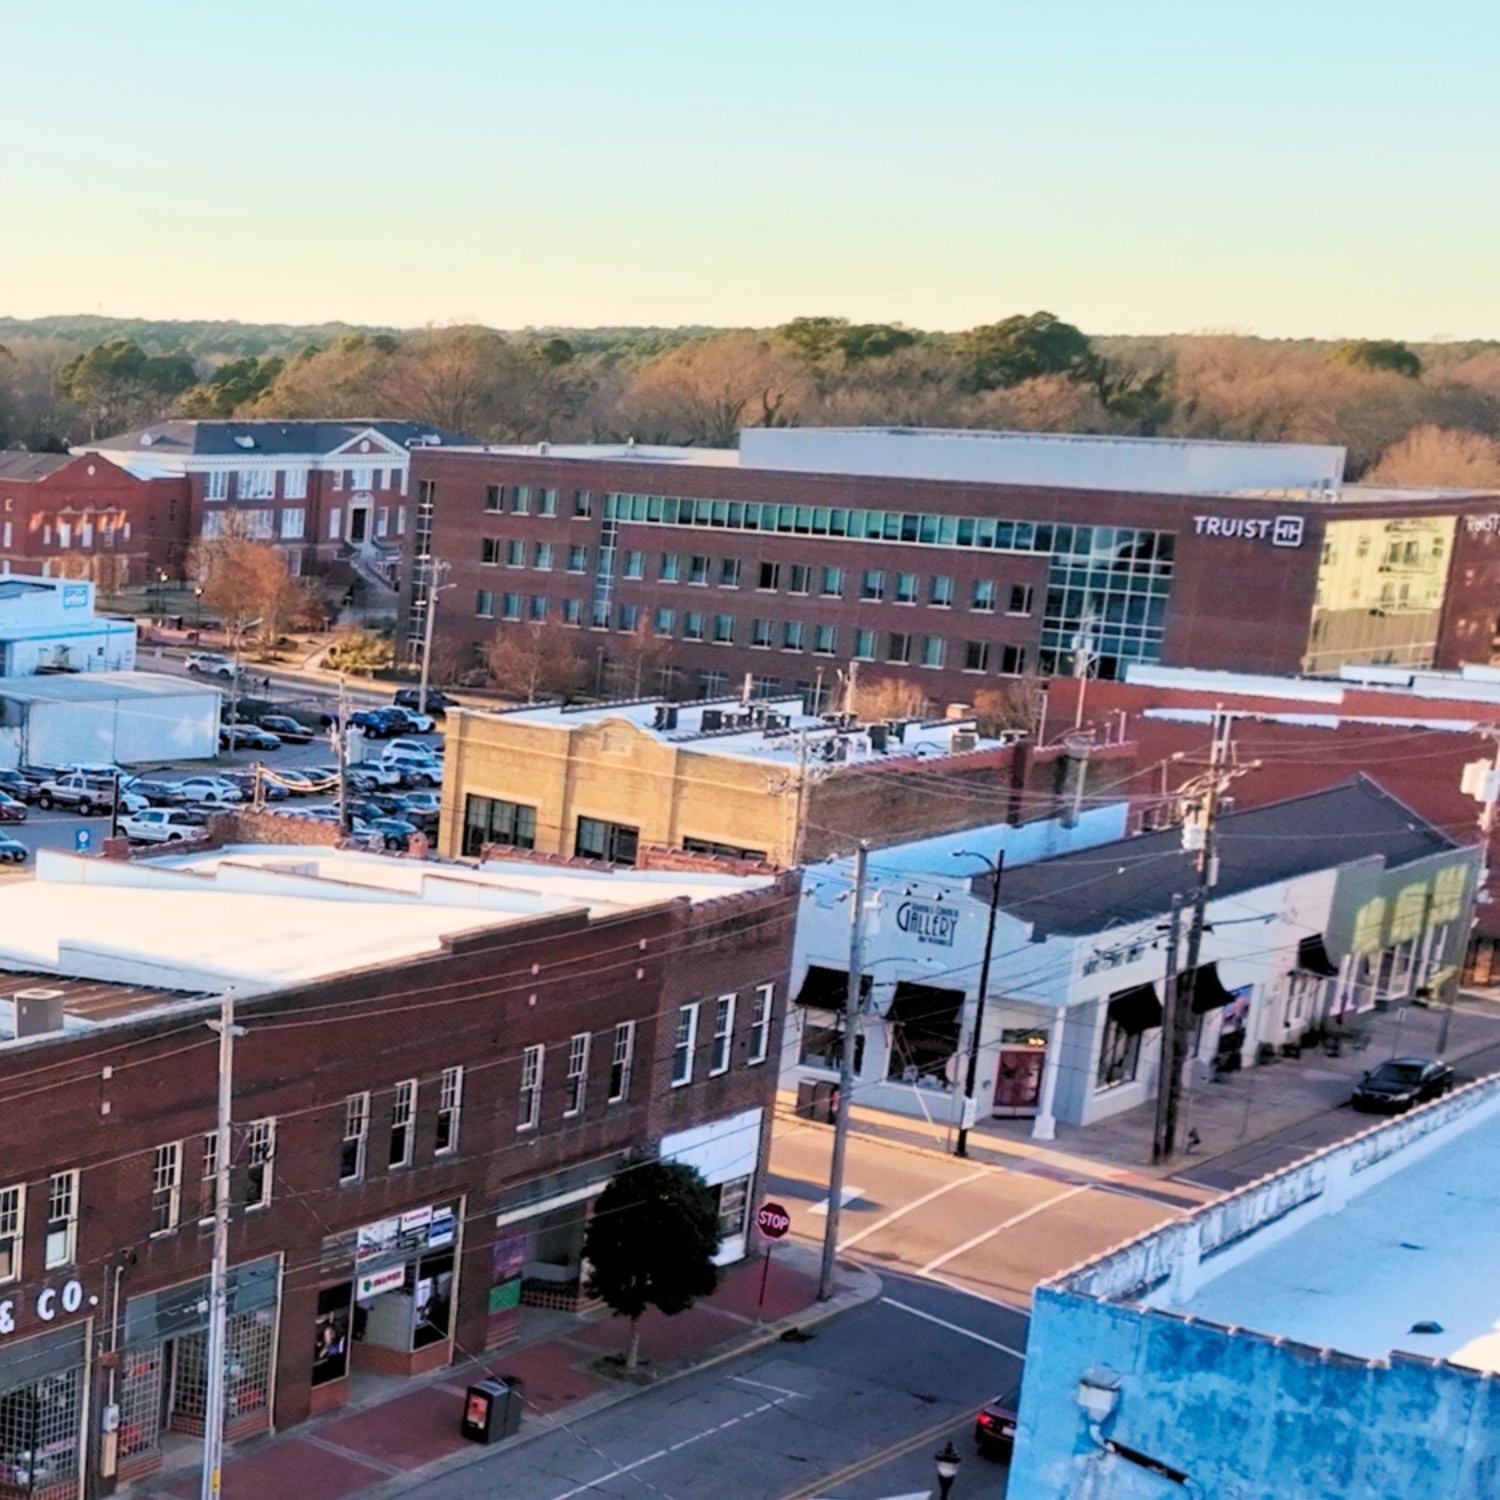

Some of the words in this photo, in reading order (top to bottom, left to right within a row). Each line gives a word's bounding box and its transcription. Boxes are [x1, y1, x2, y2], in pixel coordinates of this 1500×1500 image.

[1193, 516, 1273, 539] TRUIST
[897, 902, 957, 947] GALLERY
[759, 1210, 789, 1230] STOP
[37, 1280, 98, 1321] CO.
